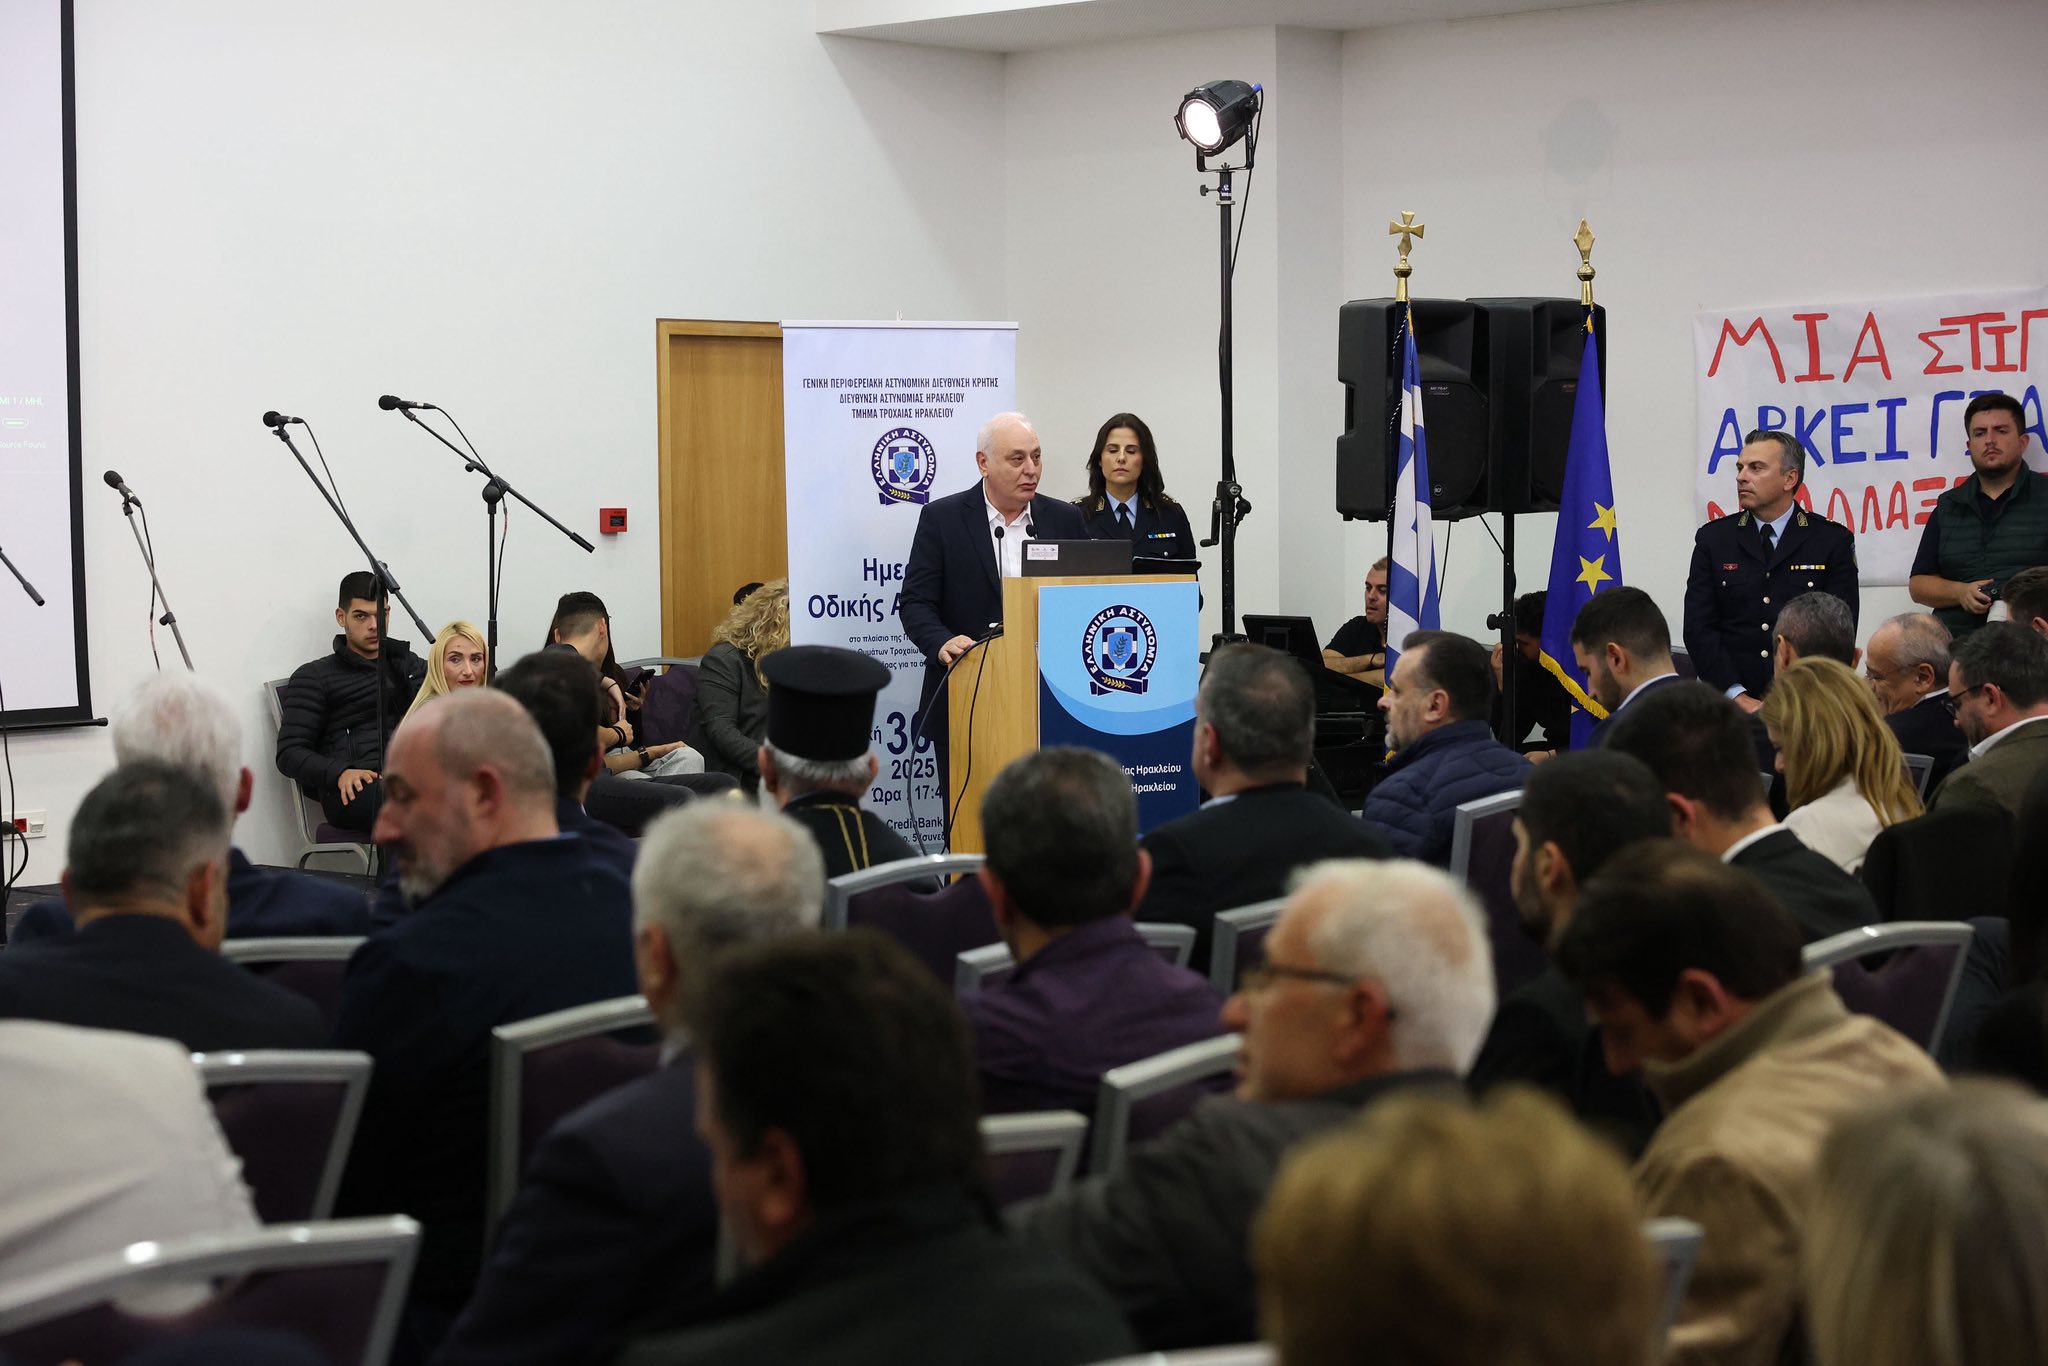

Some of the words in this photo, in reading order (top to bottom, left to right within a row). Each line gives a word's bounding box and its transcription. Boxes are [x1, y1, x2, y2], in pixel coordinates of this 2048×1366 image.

[1706, 311, 1892, 384] ΜΙΑ
[802, 378, 829, 389] ΓΕΝΙΚΗ
[830, 378, 883, 389] ΠΕΡΙΦΕΡΕΙΑΚΗ
[885, 377, 930, 388] ΑΣΤΥΝΟΜΙΚΗ
[932, 377, 970, 388] ΔΙΕΥΘΥΝΣΗ
[972, 377, 999, 388] ΚΡΗΤΗΣ
[839, 393, 878, 404] ΔΙΕΥΘΥΝΣΗ
[880, 392, 924, 404] ΑΣΤΥΝΟΜΙΑΣ
[926, 392, 965, 403] ΗΡΑΚΛΕΙΟΥ
[851, 408, 878, 419] ΤΜΗΜΑ
[879, 408, 913, 419] ΤΡΟΧΑΙΑΣ
[914, 407, 954, 418] ΗΡΑΚΛΕΙΟΥ
[873, 430, 899, 487] ΕΛΛΗΝΙΚΗ
[902, 429, 935, 486] ΑΣΤΥΝΟΜΙΑ
[863, 557, 908, 587] Ημε
[808, 592, 884, 623] Οδικής
[862, 634, 889, 643] πλαίσιο
[890, 634, 902, 643] της
[1085, 608, 1115, 674] ΕΛΛΗΝΙΚΗ
[1119, 607, 1156, 672] ΑΣΤΥΝΟΜΙΑ
[890, 646, 921, 656] Τροχαίω
[891, 757, 935, 780] 2025
[1136, 762, 1182, 776] Ηρακλείου
[1131, 781, 1177, 795] Ηρακλείου
[871, 787, 902, 806] Ώρα
